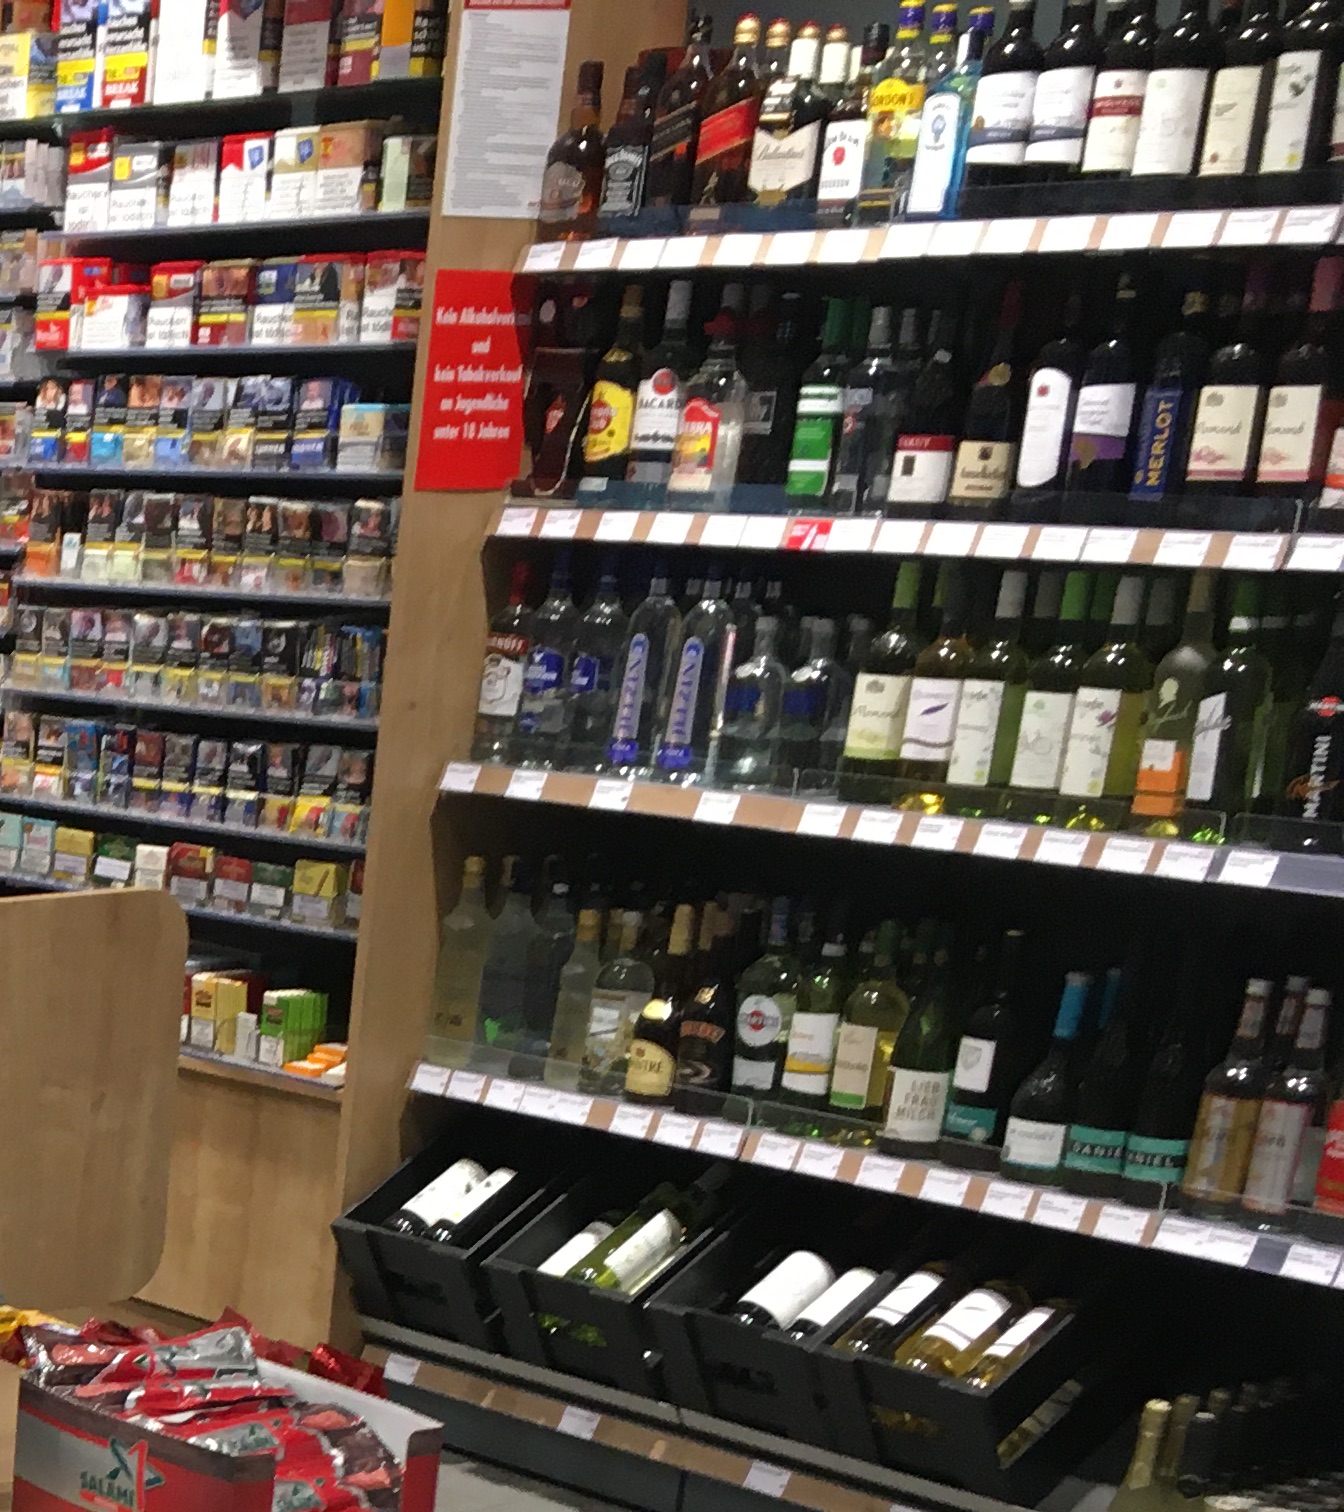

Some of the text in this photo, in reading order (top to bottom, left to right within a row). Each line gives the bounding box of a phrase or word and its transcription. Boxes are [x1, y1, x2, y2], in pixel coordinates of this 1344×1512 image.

[436, 306, 458, 324] Kein
[471, 336, 491, 354] und
[462, 421, 475, 438] 18
[477, 421, 511, 440] Jahren
[1147, 400, 1176, 486] MERLOT
